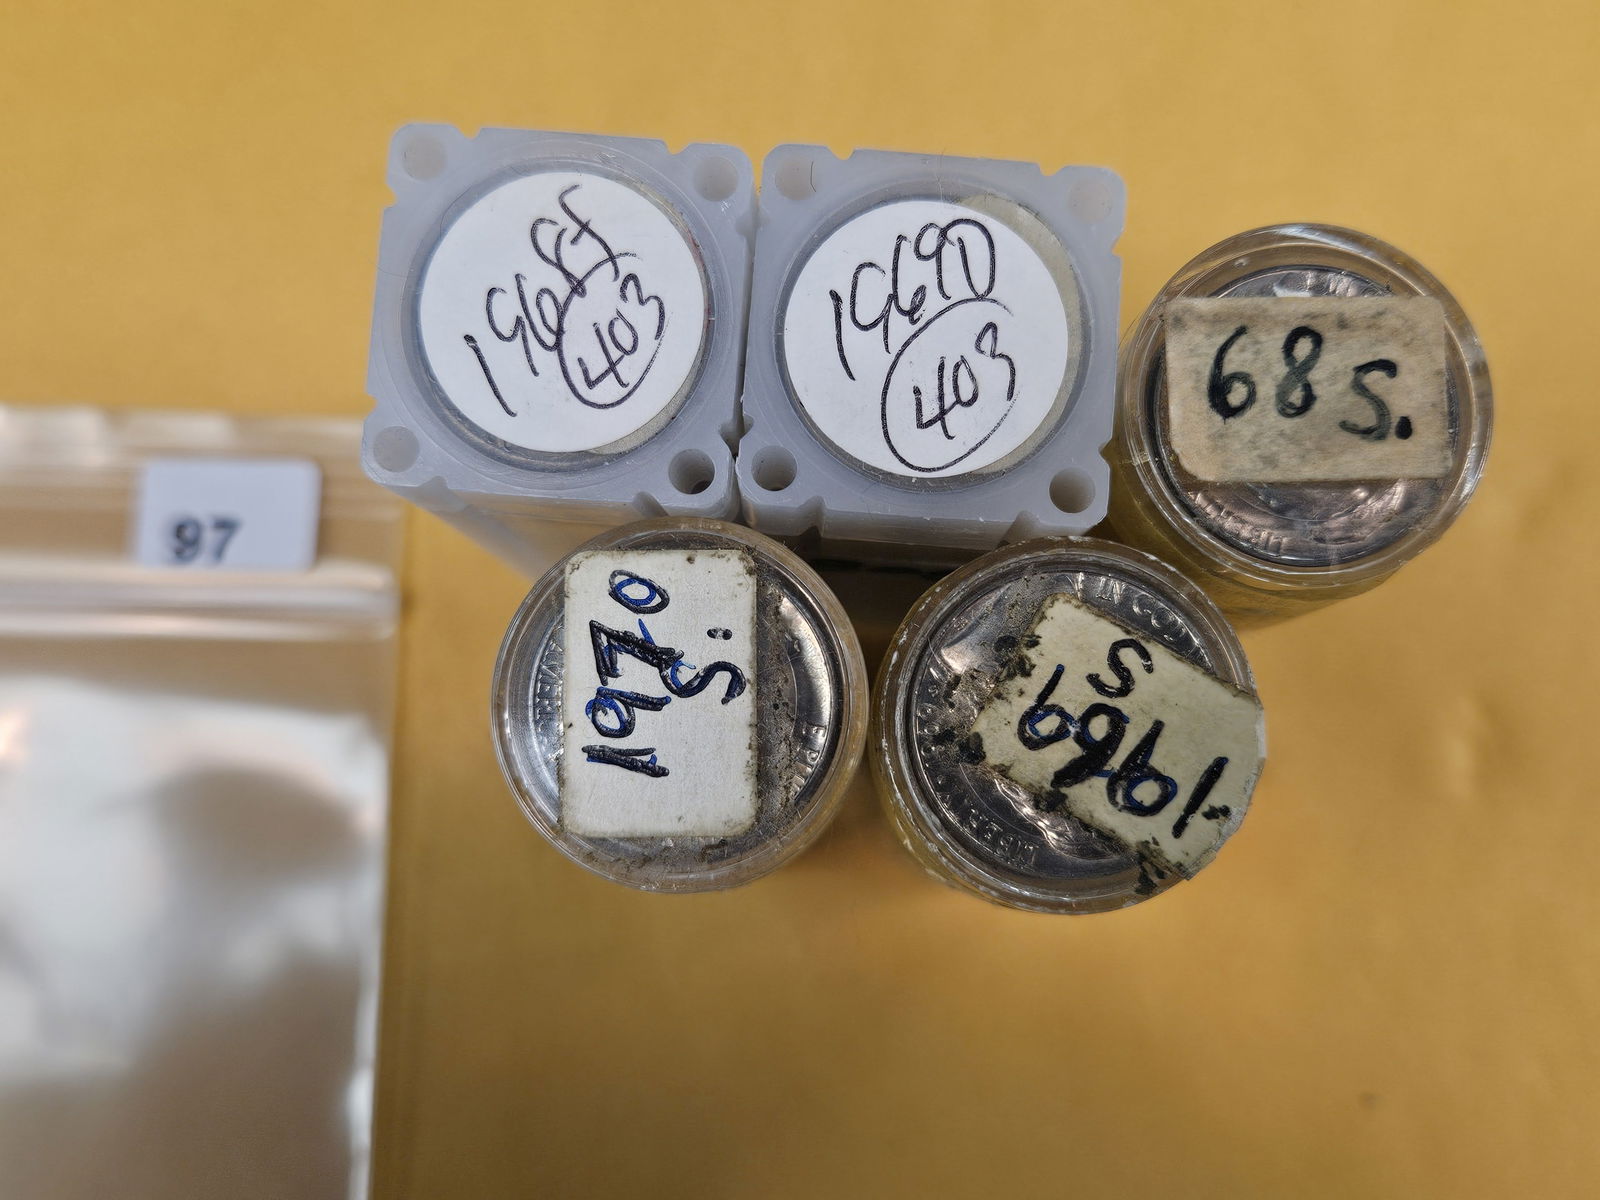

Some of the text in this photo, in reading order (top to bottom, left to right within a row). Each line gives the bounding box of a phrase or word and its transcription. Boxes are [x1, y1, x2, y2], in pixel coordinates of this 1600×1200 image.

[577, 272, 666, 389] 403
[828, 217, 997, 382] 1969D
[911, 321, 1017, 441] 403
[172, 514, 242, 566] 97
[581, 569, 671, 778] 1970
[1086, 638, 1154, 699] S
[1017, 664, 1229, 839] 1969
